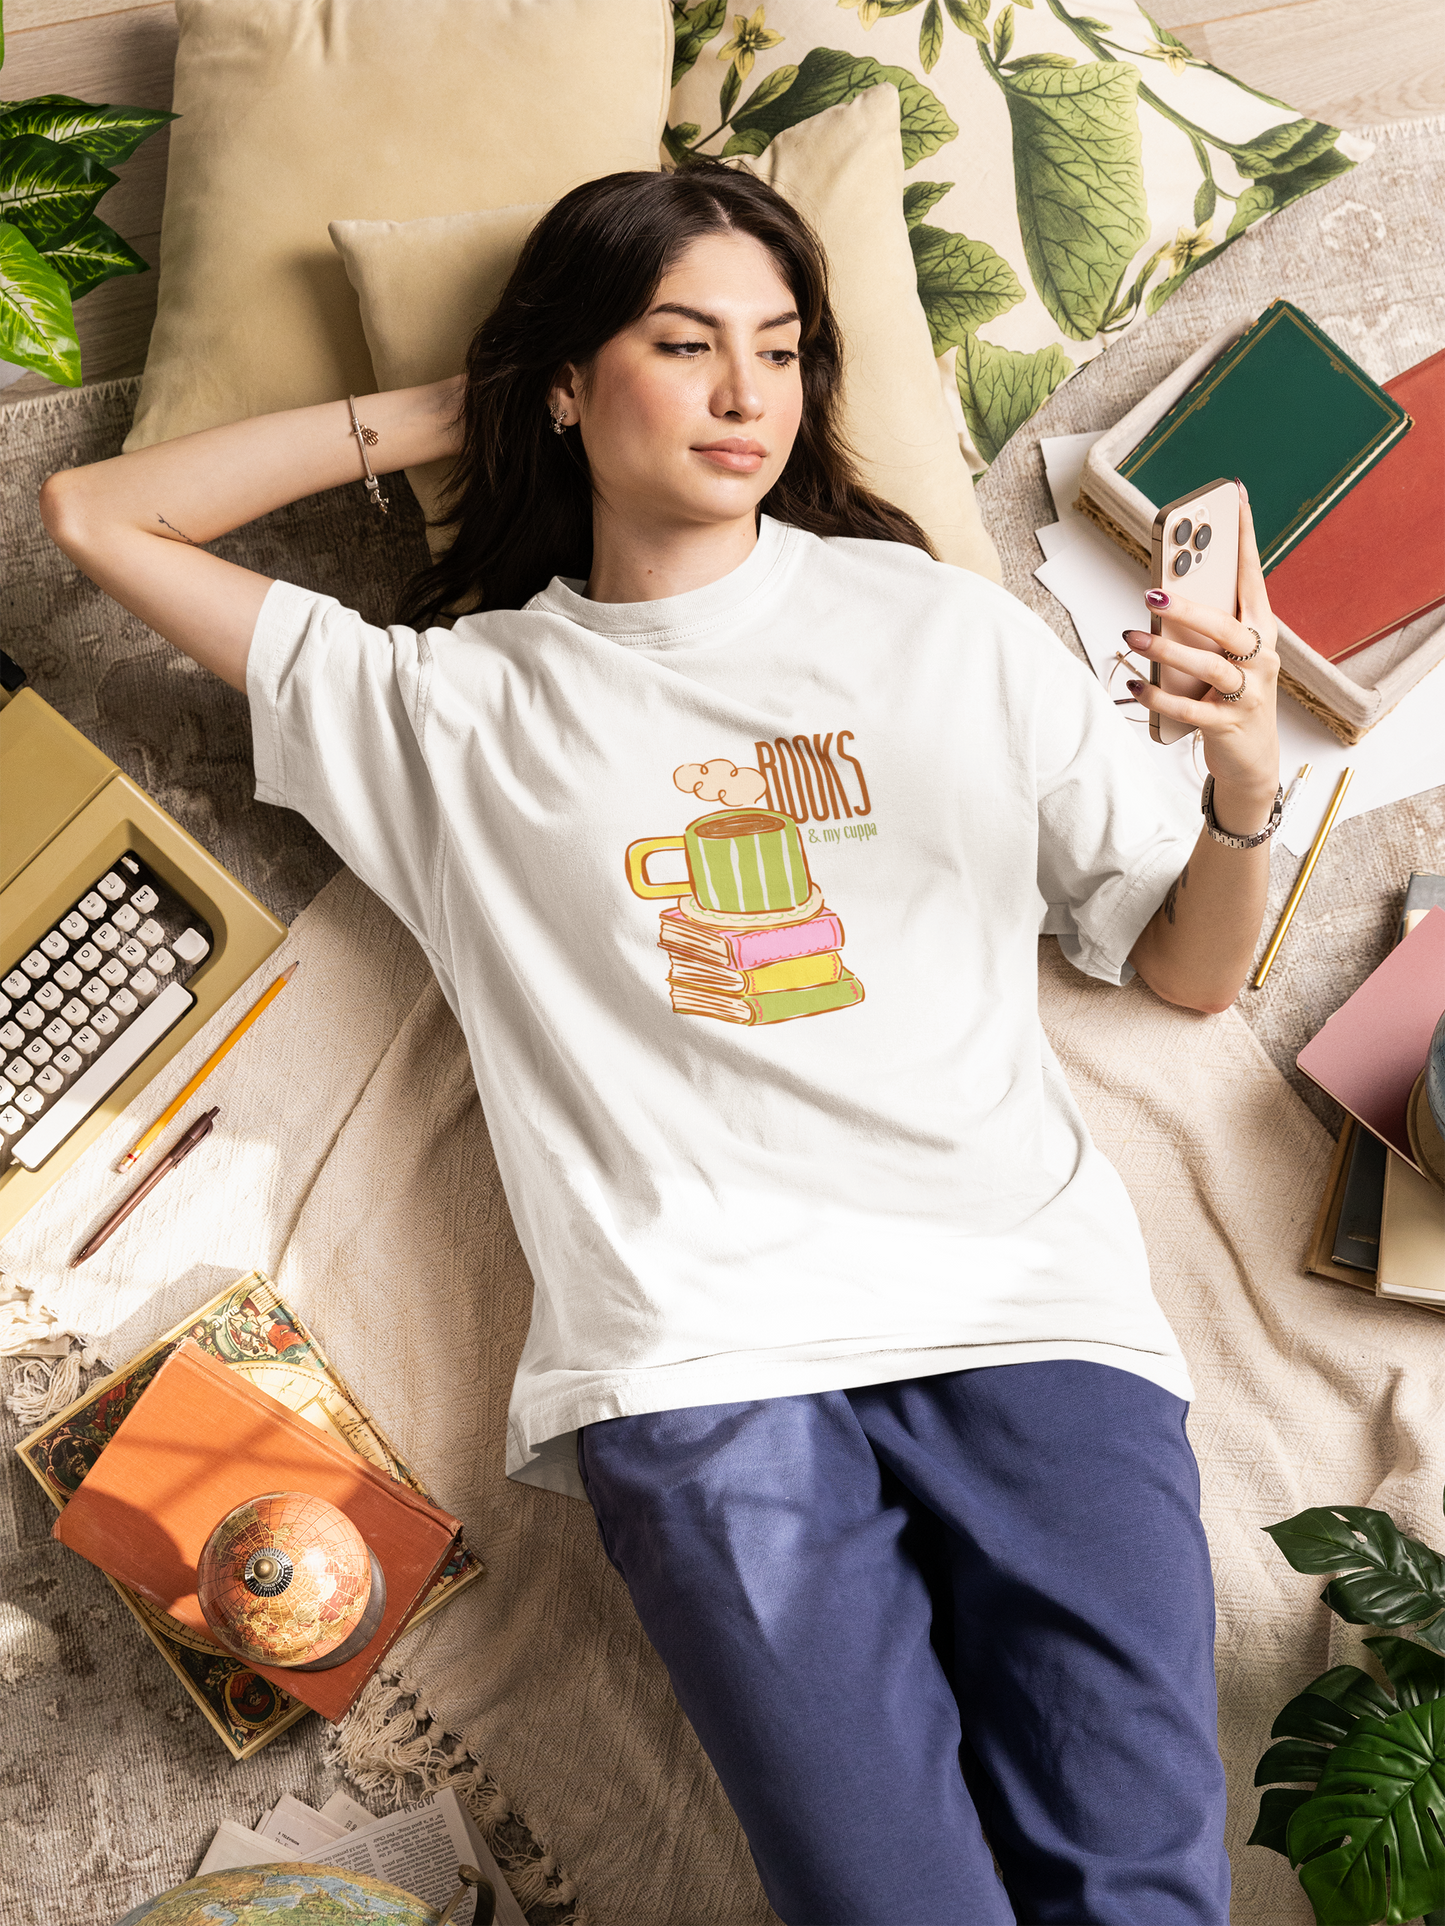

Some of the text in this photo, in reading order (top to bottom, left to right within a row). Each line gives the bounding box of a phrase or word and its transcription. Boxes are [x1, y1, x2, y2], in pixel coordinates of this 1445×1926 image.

[754, 730, 871, 824] BOOKS
[808, 822, 878, 845] & my cuppa
[3, 1028, 11, 1036] T
[23, 1008, 31, 1016] Y
[42, 989, 51, 998] U
[81, 950, 90, 958] O
[99, 930, 107, 939] P
[11, 1064, 18, 1073] F
[31, 1044, 41, 1053] G
[50, 1024, 60, 1033] H
[88, 985, 98, 993] K
[125, 945, 136, 956] Ñ
[3, 1114, 12, 1122] X
[23, 1093, 32, 1102] C
[61, 1054, 70, 1063] B
[79, 1033, 89, 1042] N
[97, 1014, 108, 1023] M
[212, 1305, 240, 1329] BLUME
[403, 1795, 436, 1814] JAPAN
